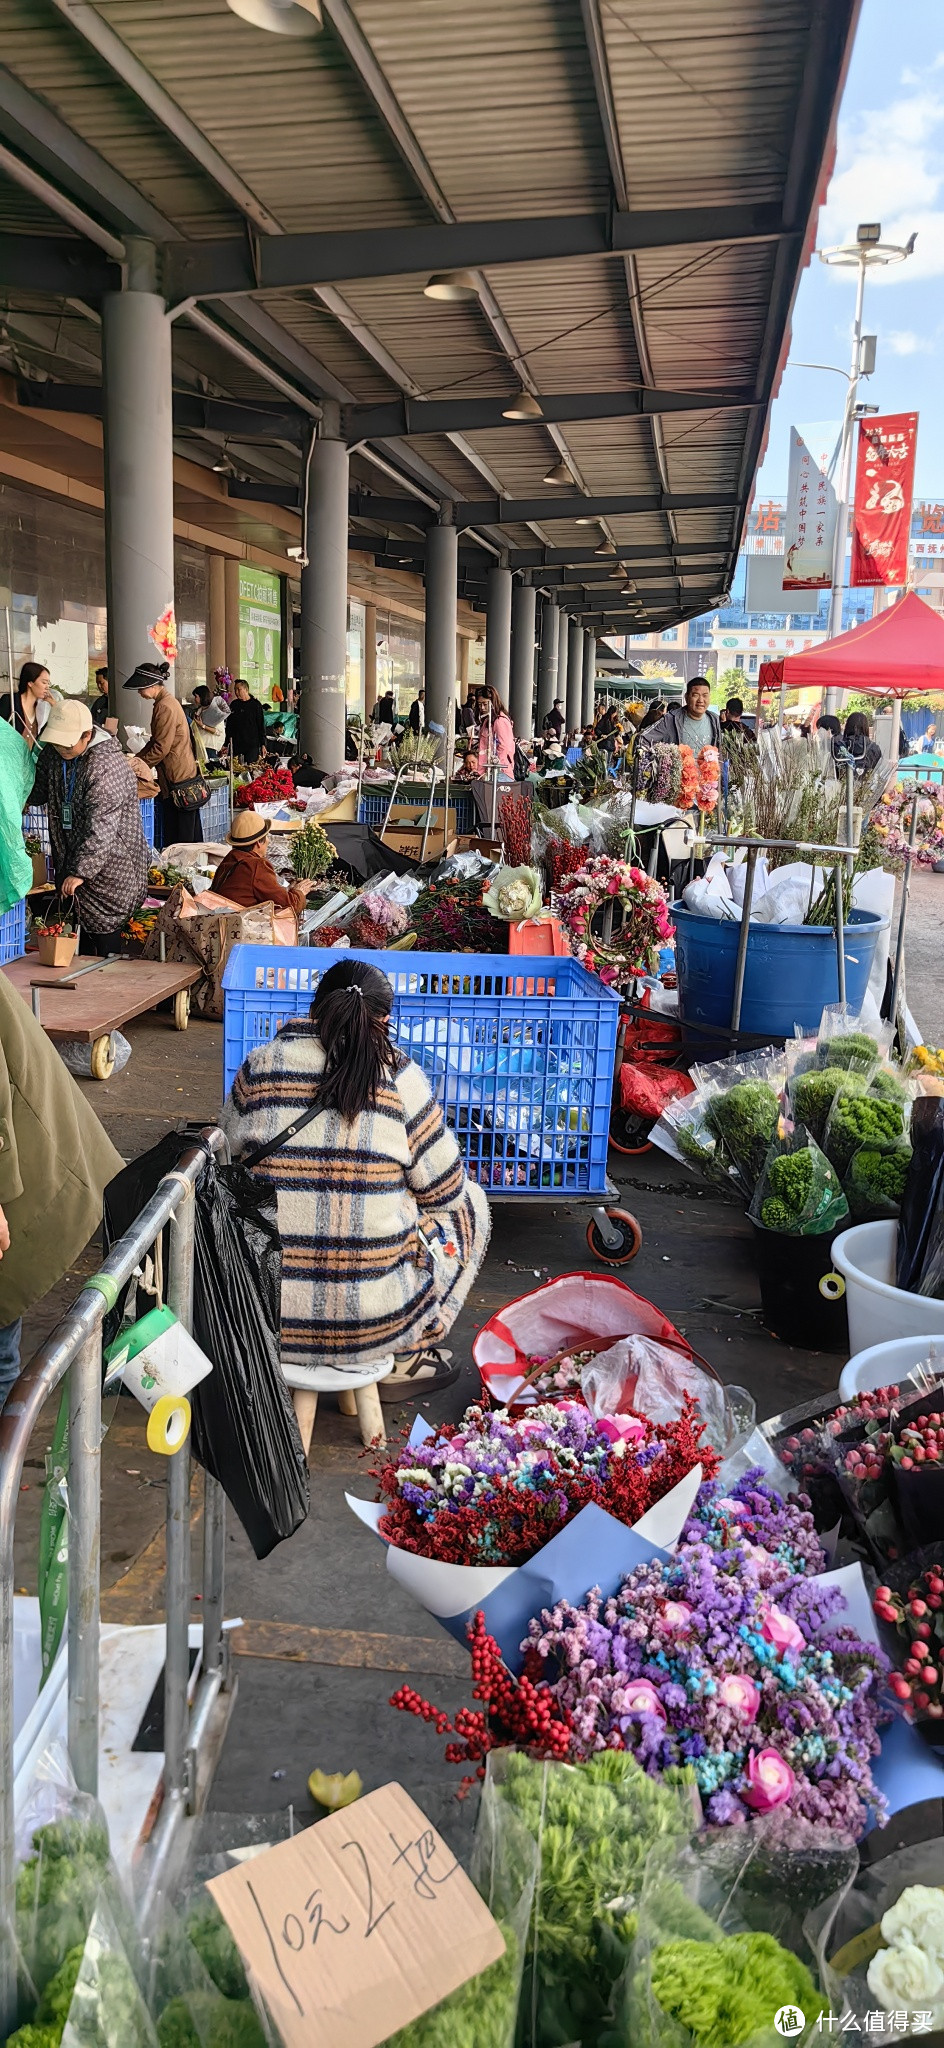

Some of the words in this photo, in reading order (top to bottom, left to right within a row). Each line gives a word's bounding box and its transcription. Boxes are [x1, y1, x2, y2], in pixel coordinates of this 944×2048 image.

[754, 500, 782, 532] 店
[797, 455, 810, 547] 同心共筑中国梦
[815, 452, 828, 547] 中华民族一家亲
